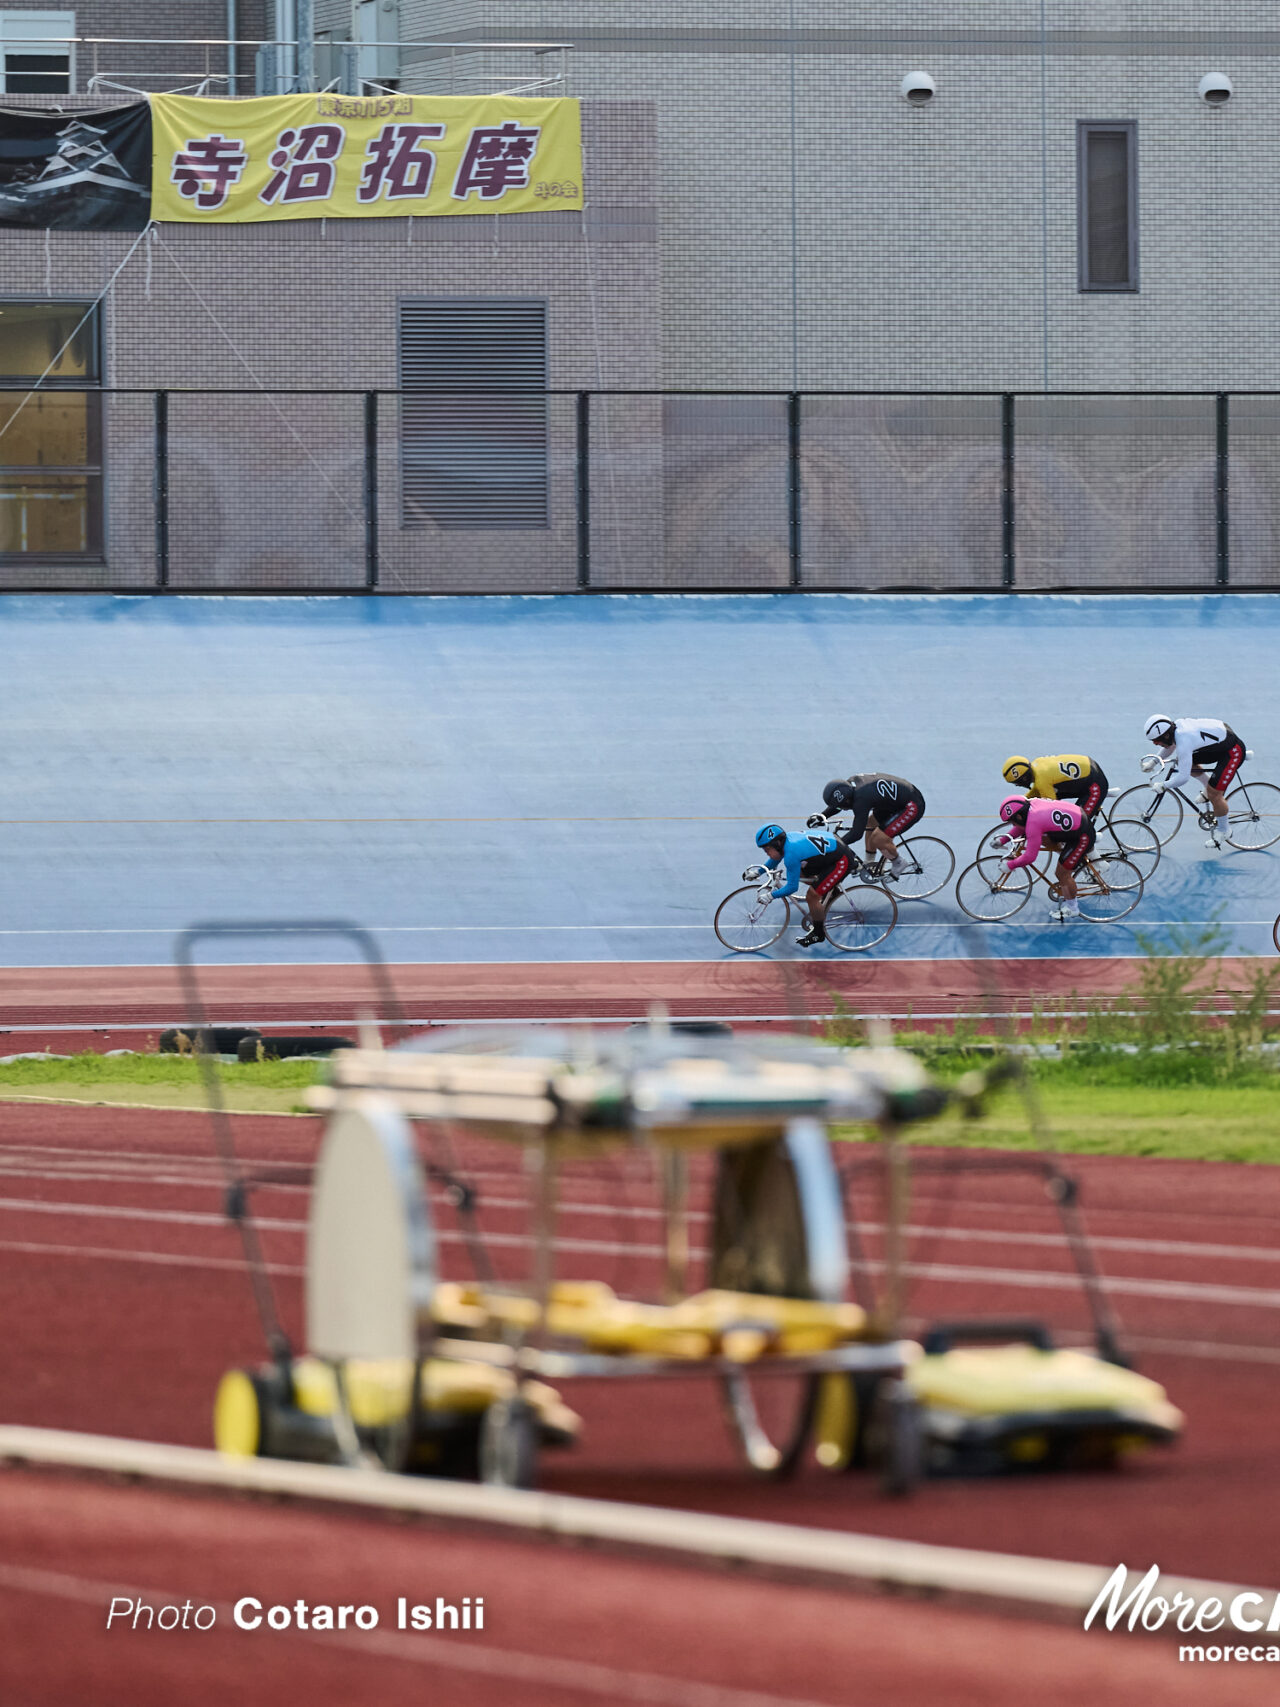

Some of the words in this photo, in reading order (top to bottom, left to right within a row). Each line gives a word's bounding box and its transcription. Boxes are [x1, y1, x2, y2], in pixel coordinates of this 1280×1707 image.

[172, 122, 541, 210] 寺沼拓摩
[1200, 730, 1220, 742] 1
[1011, 767, 1020, 779] 5
[1058, 761, 1081, 780] 5
[833, 789, 844, 802] 2
[876, 779, 898, 801] 2
[1005, 804, 1013, 816] 8
[1051, 809, 1074, 831] 8
[767, 826, 775, 840] 4
[805, 834, 831, 856] 4
